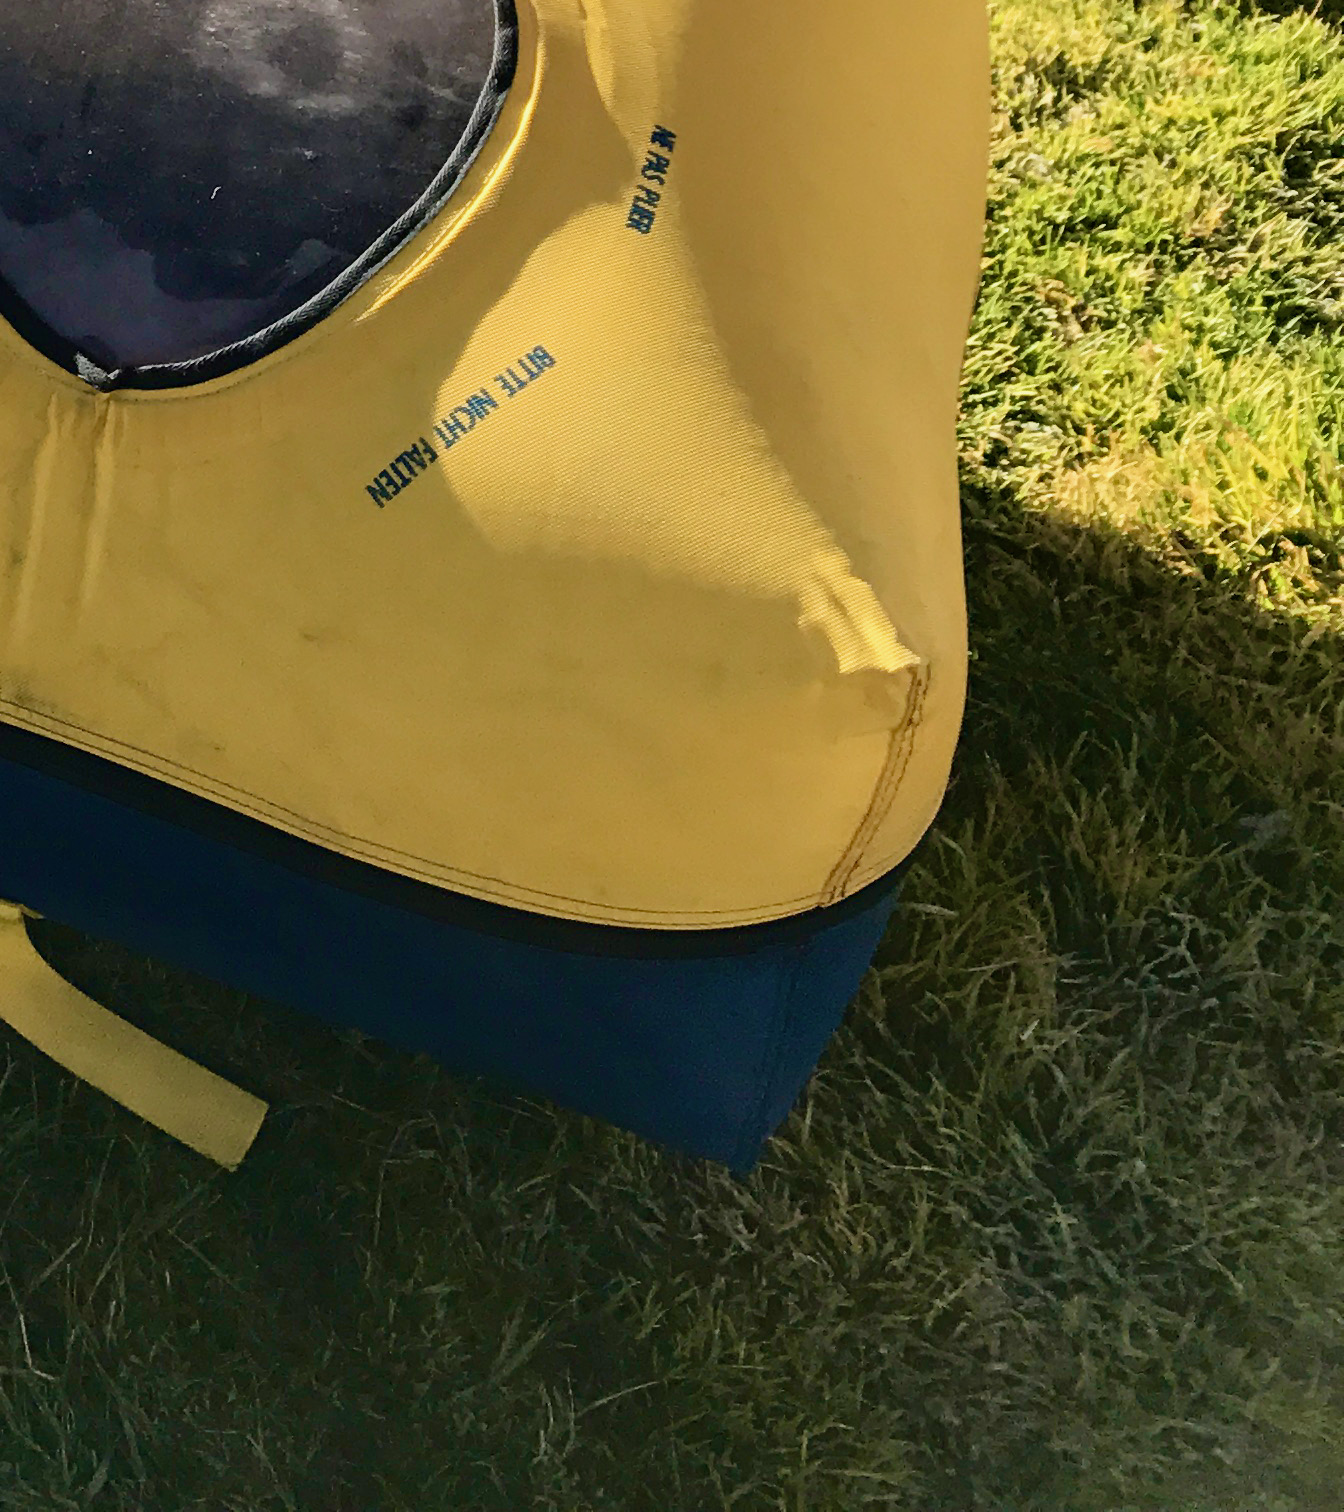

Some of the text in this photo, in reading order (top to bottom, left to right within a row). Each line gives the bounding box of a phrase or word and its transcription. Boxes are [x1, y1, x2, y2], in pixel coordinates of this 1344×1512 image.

[625, 124, 677, 234] NE PAS PLIER
[365, 345, 556, 509] BITTE NICHT FALTEN
